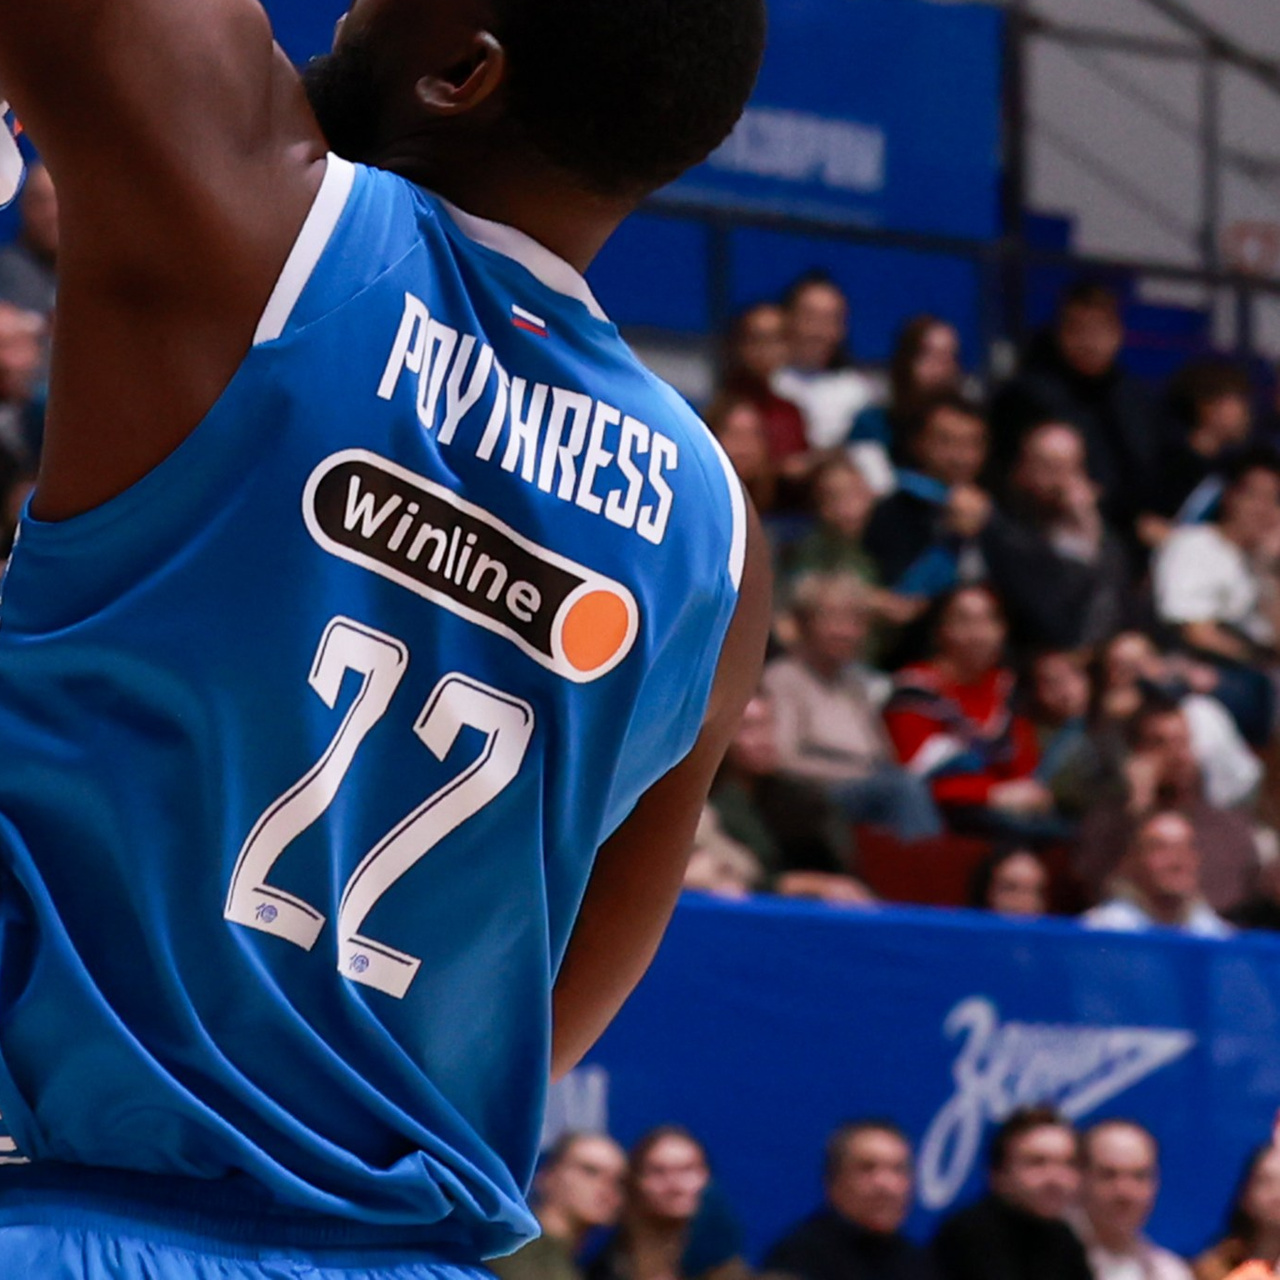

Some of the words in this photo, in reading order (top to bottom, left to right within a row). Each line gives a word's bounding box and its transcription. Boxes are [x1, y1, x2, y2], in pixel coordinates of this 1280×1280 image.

[376, 291, 678, 546] POYTHRESS
[343, 474, 542, 623] Winline
[223, 614, 535, 1000] 22
